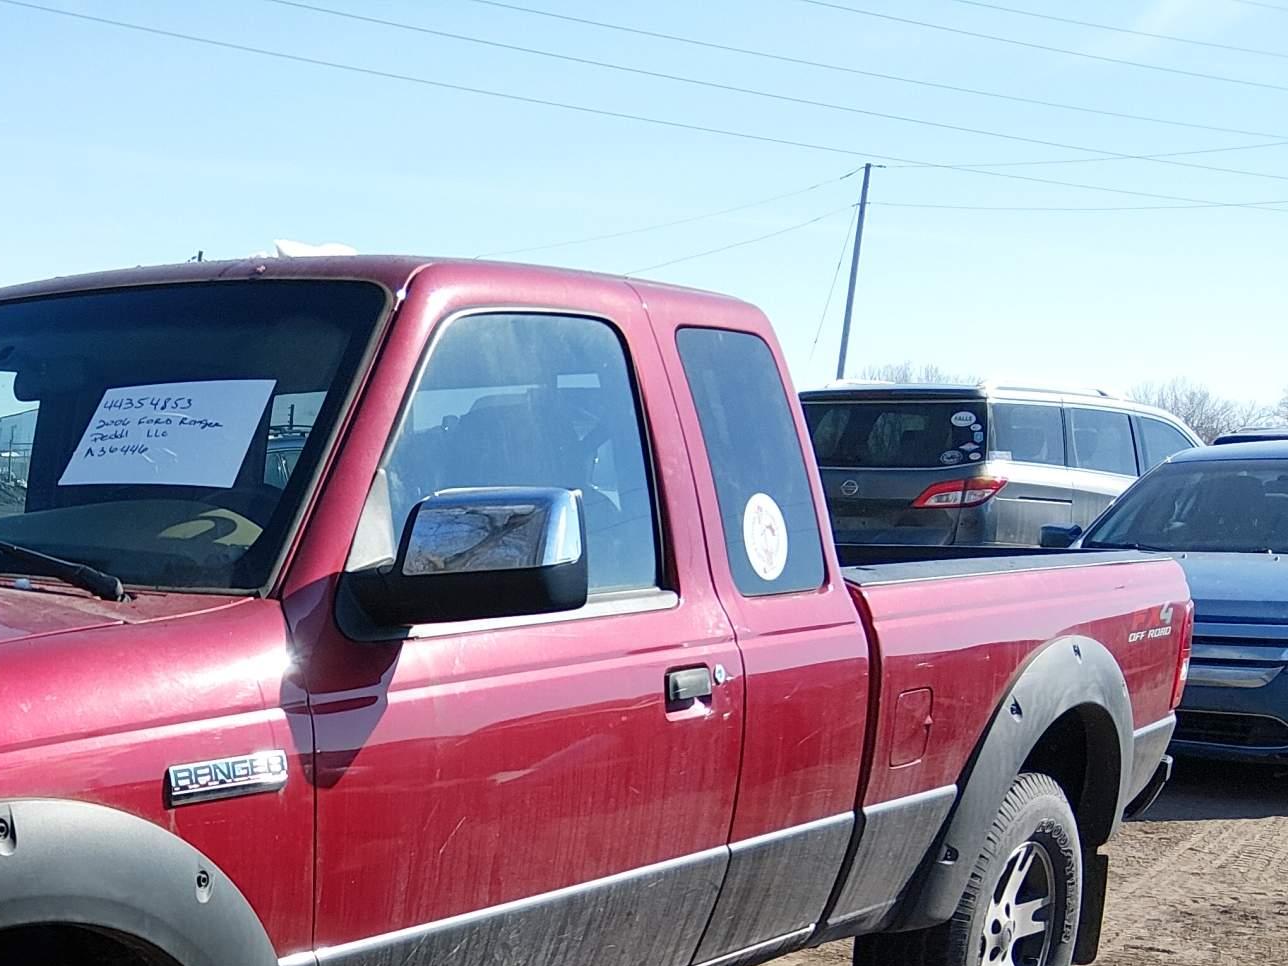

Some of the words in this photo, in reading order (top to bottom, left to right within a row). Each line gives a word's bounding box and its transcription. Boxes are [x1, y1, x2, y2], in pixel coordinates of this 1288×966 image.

[103, 397, 193, 411] 44354853
[96, 417, 131, 429] 2006
[1128, 630, 1147, 643] OFF
[1147, 625, 1172, 639] ROAD
